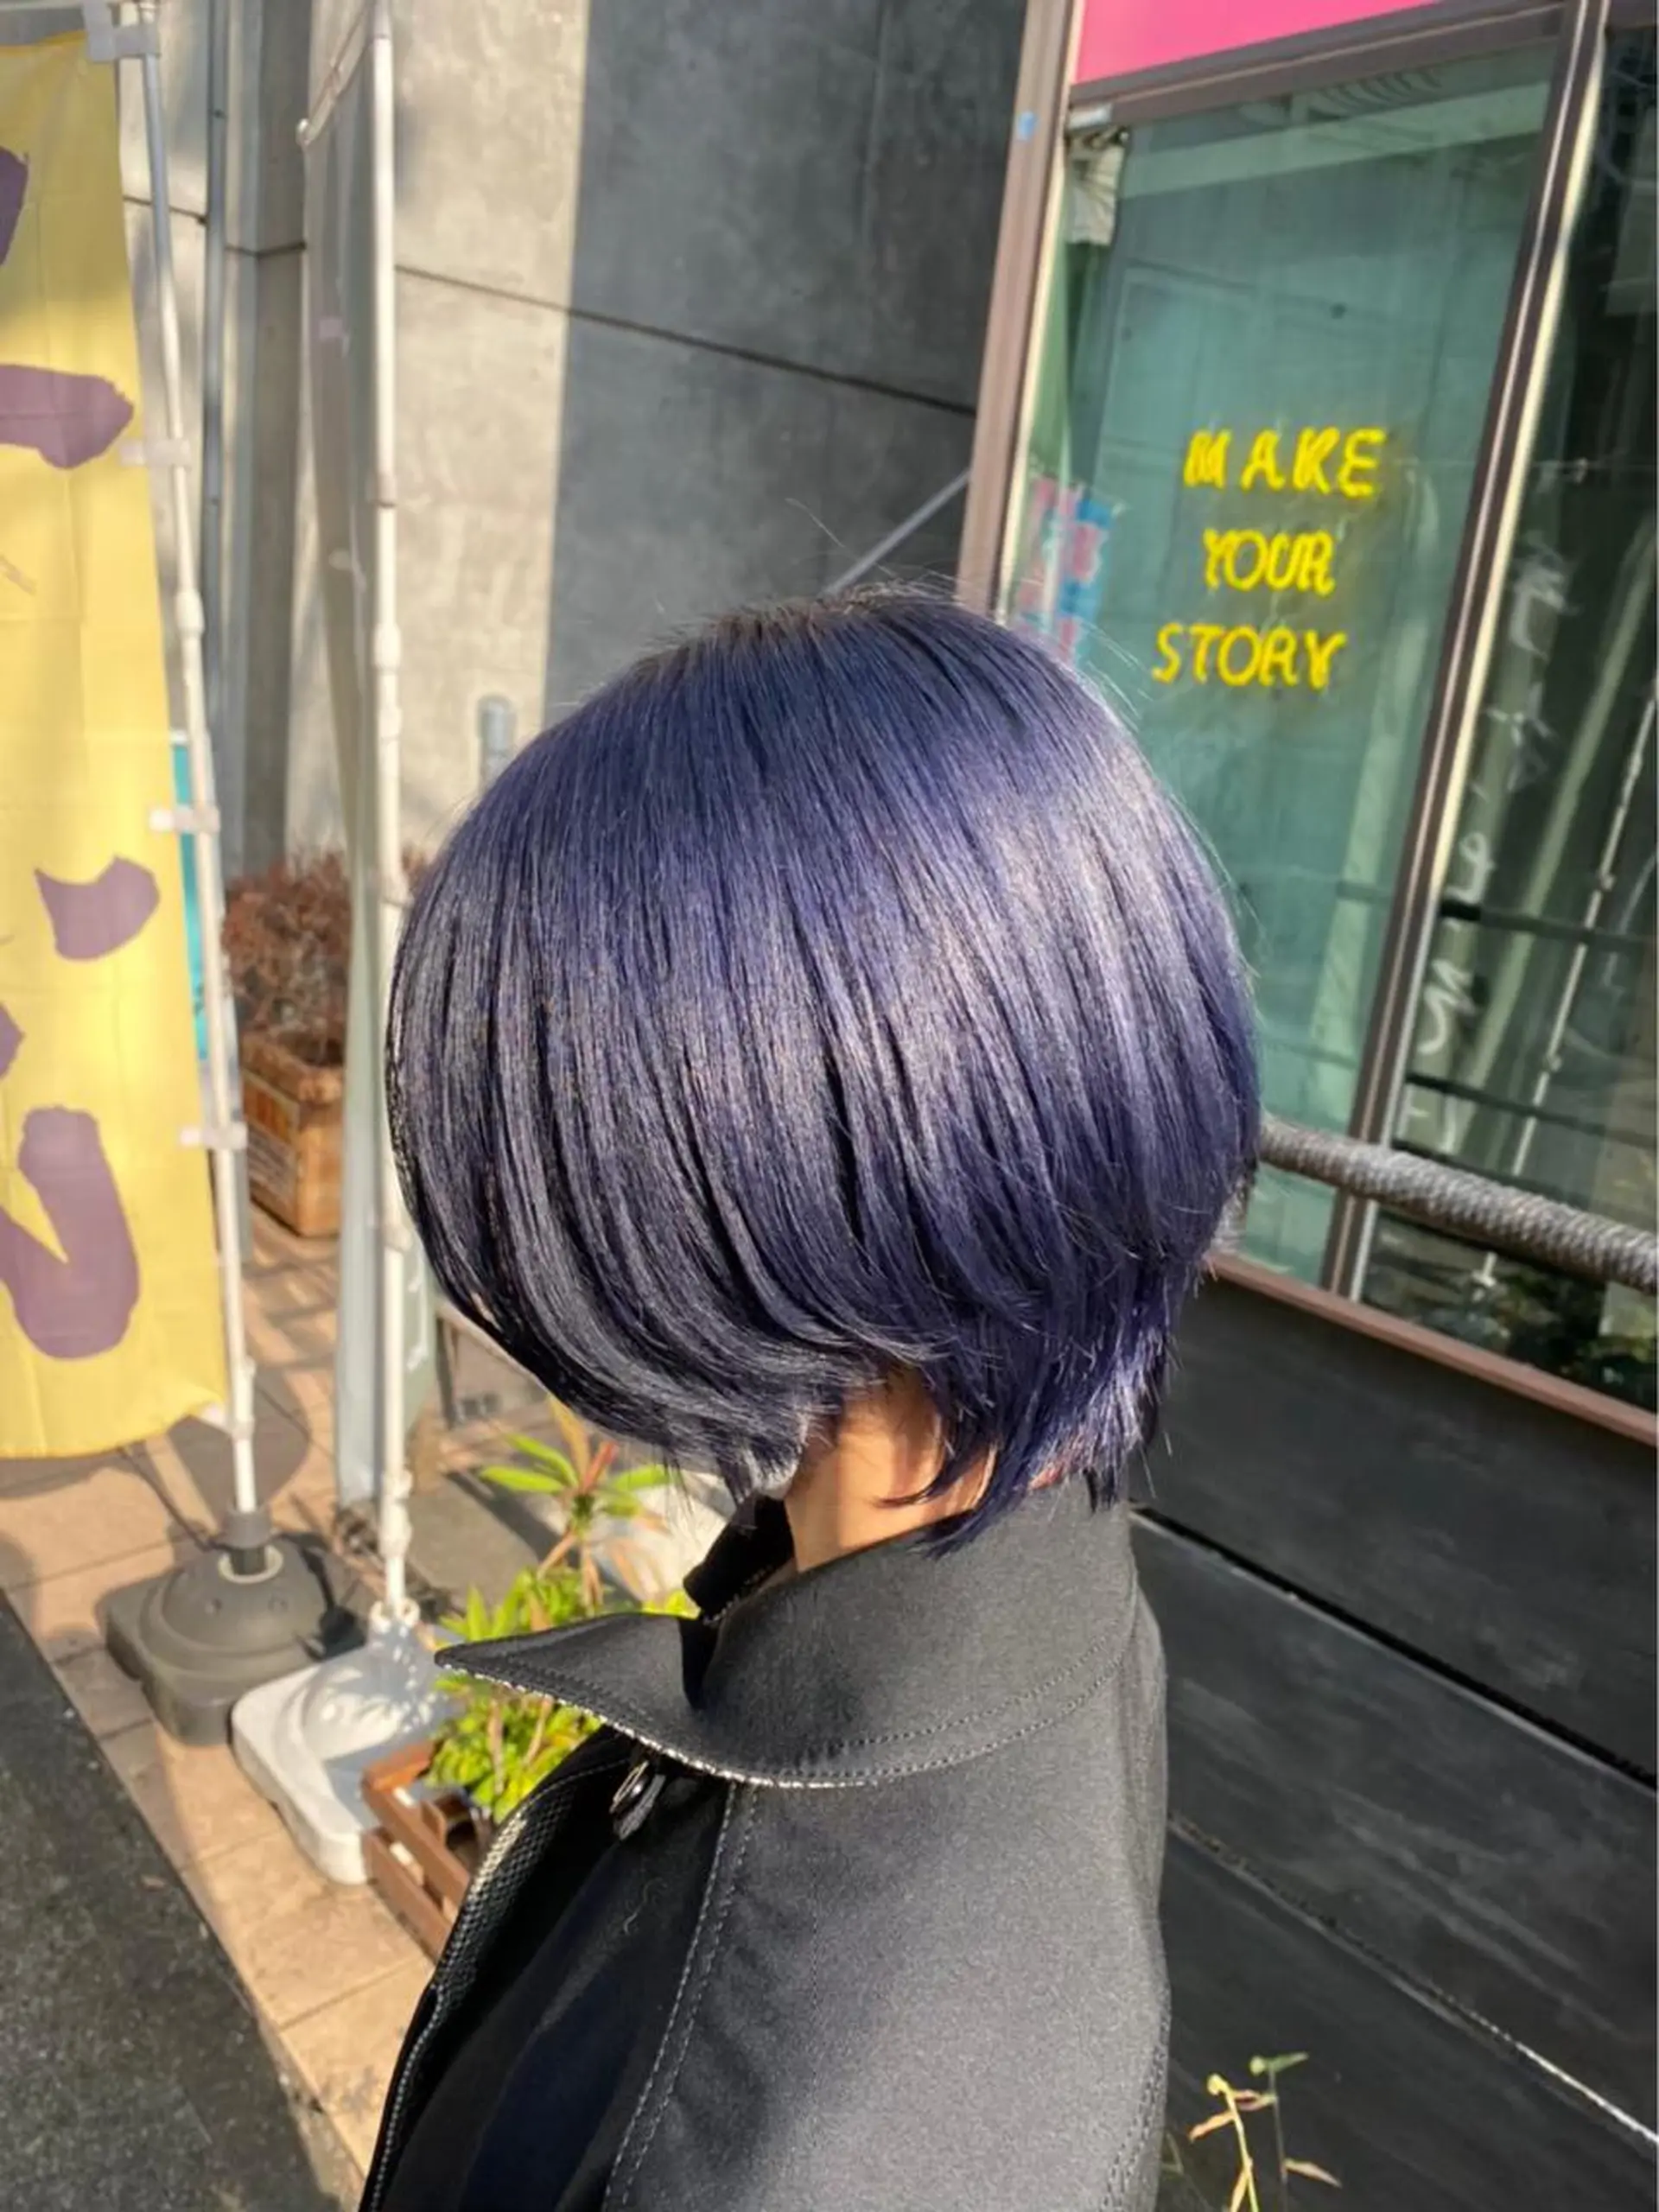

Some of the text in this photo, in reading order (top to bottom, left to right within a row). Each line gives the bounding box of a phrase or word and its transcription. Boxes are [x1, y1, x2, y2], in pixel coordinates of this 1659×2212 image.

[1184, 427, 1386, 497] MAKE
[1204, 529, 1335, 596] YOUR
[1152, 622, 1346, 690] STORY
